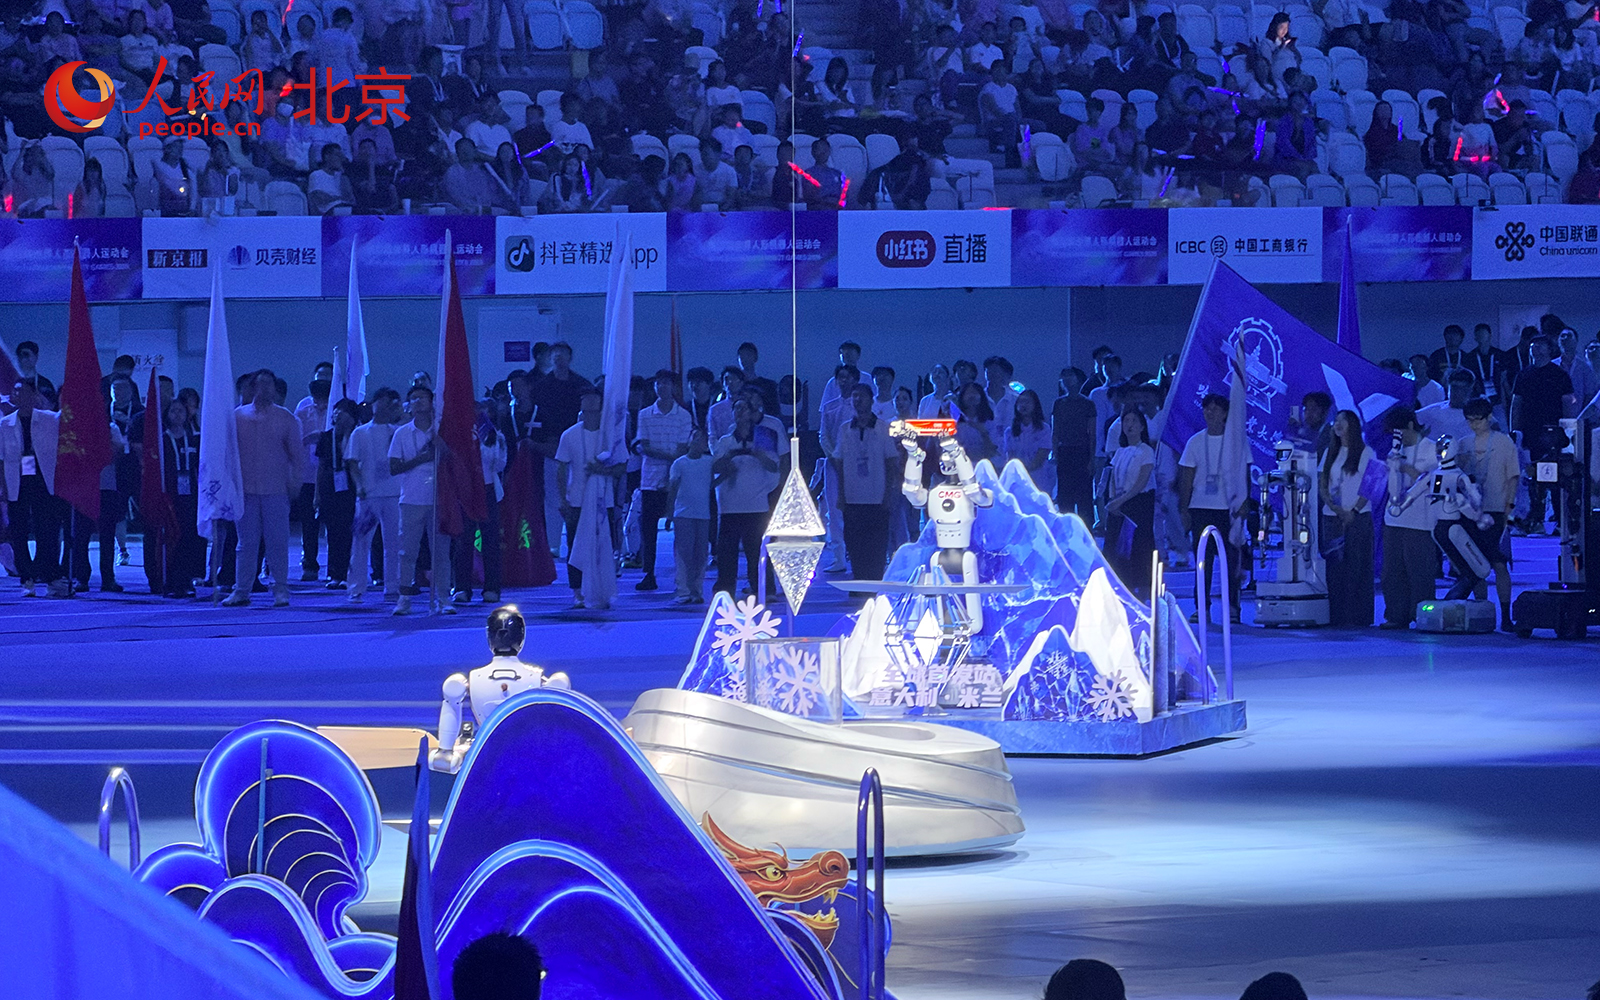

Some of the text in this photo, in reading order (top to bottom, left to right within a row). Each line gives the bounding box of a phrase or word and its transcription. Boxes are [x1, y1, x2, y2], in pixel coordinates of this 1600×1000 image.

[1540, 225, 1598, 243] 中国联通
[884, 233, 988, 264] 小红书 直播
[1175, 240, 1207, 254] ICBC
[1234, 238, 1308, 253] 中国工商银行
[1540, 246, 1565, 256] China
[152, 250, 204, 267] 新京报
[255, 248, 317, 266] 贝壳财经
[938, 490, 963, 499] CMG
[882, 663, 997, 685] 全球首发站
